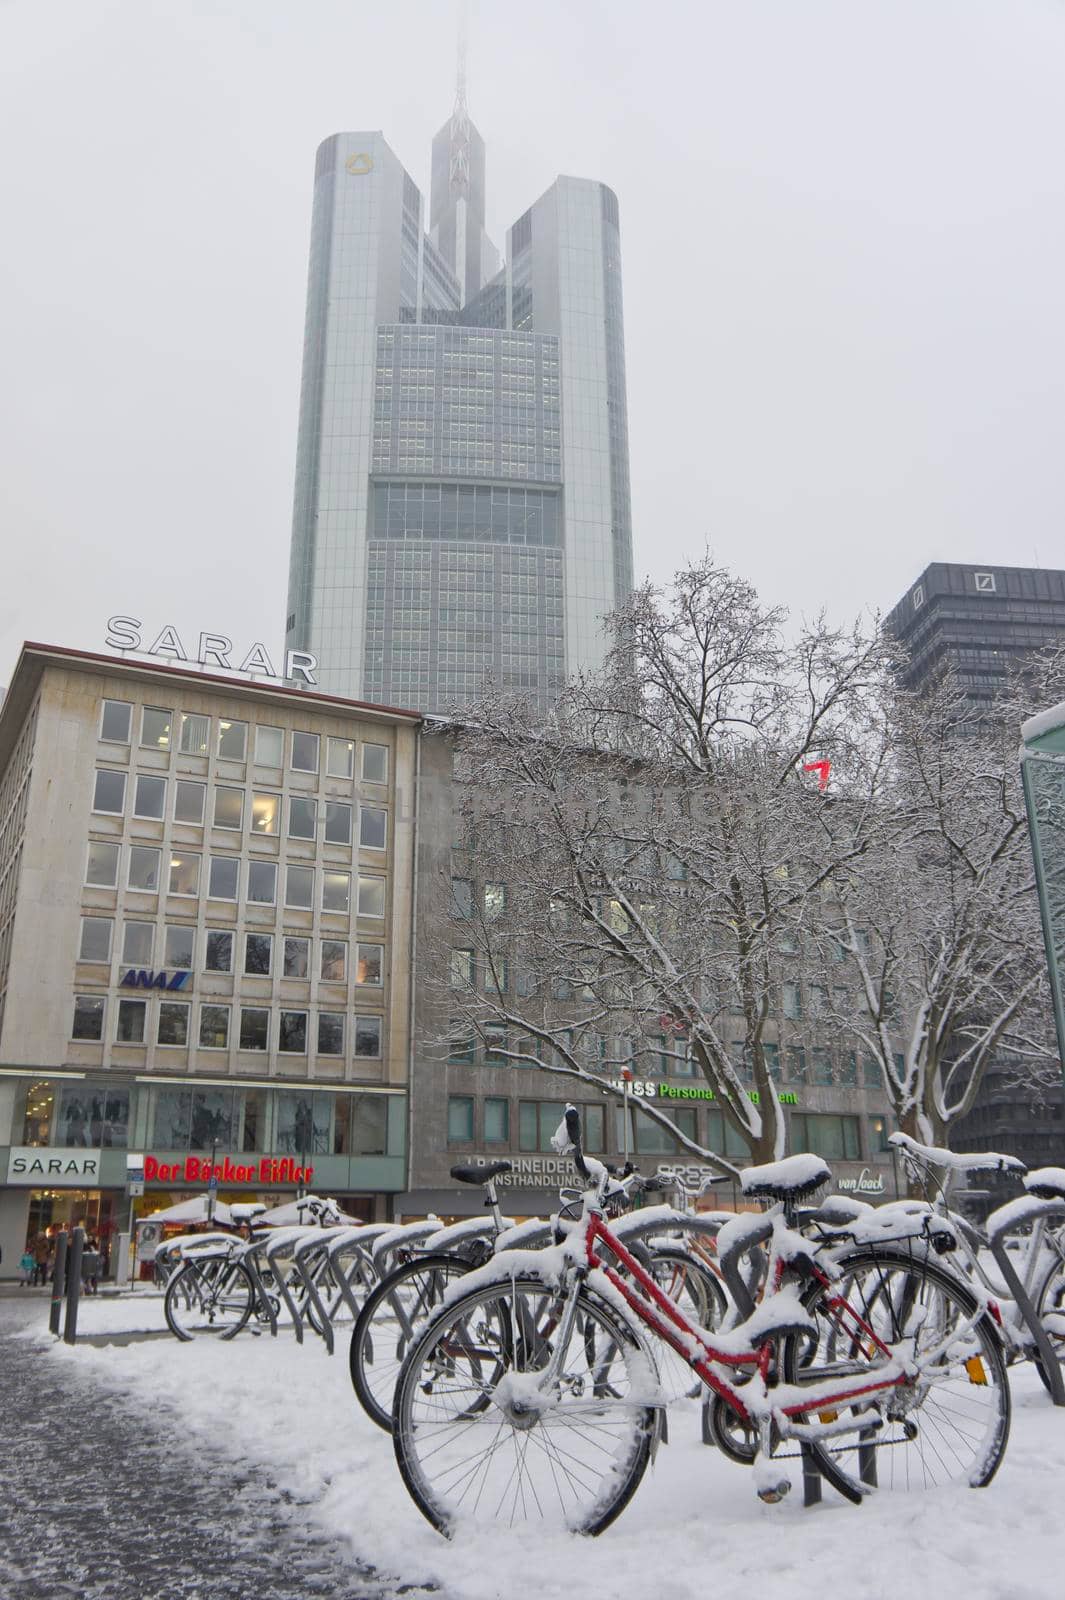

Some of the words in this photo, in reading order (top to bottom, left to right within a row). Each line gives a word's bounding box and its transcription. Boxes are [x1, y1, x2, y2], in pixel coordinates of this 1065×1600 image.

[105, 615, 318, 685] SARAR
[120, 969, 167, 990] ANA
[12, 1158, 97, 1175] SARAR
[144, 1155, 181, 1183] Der
[184, 1156, 256, 1184] Bäcker
[258, 1156, 314, 1184] Eifler
[838, 1178, 857, 1190] van
